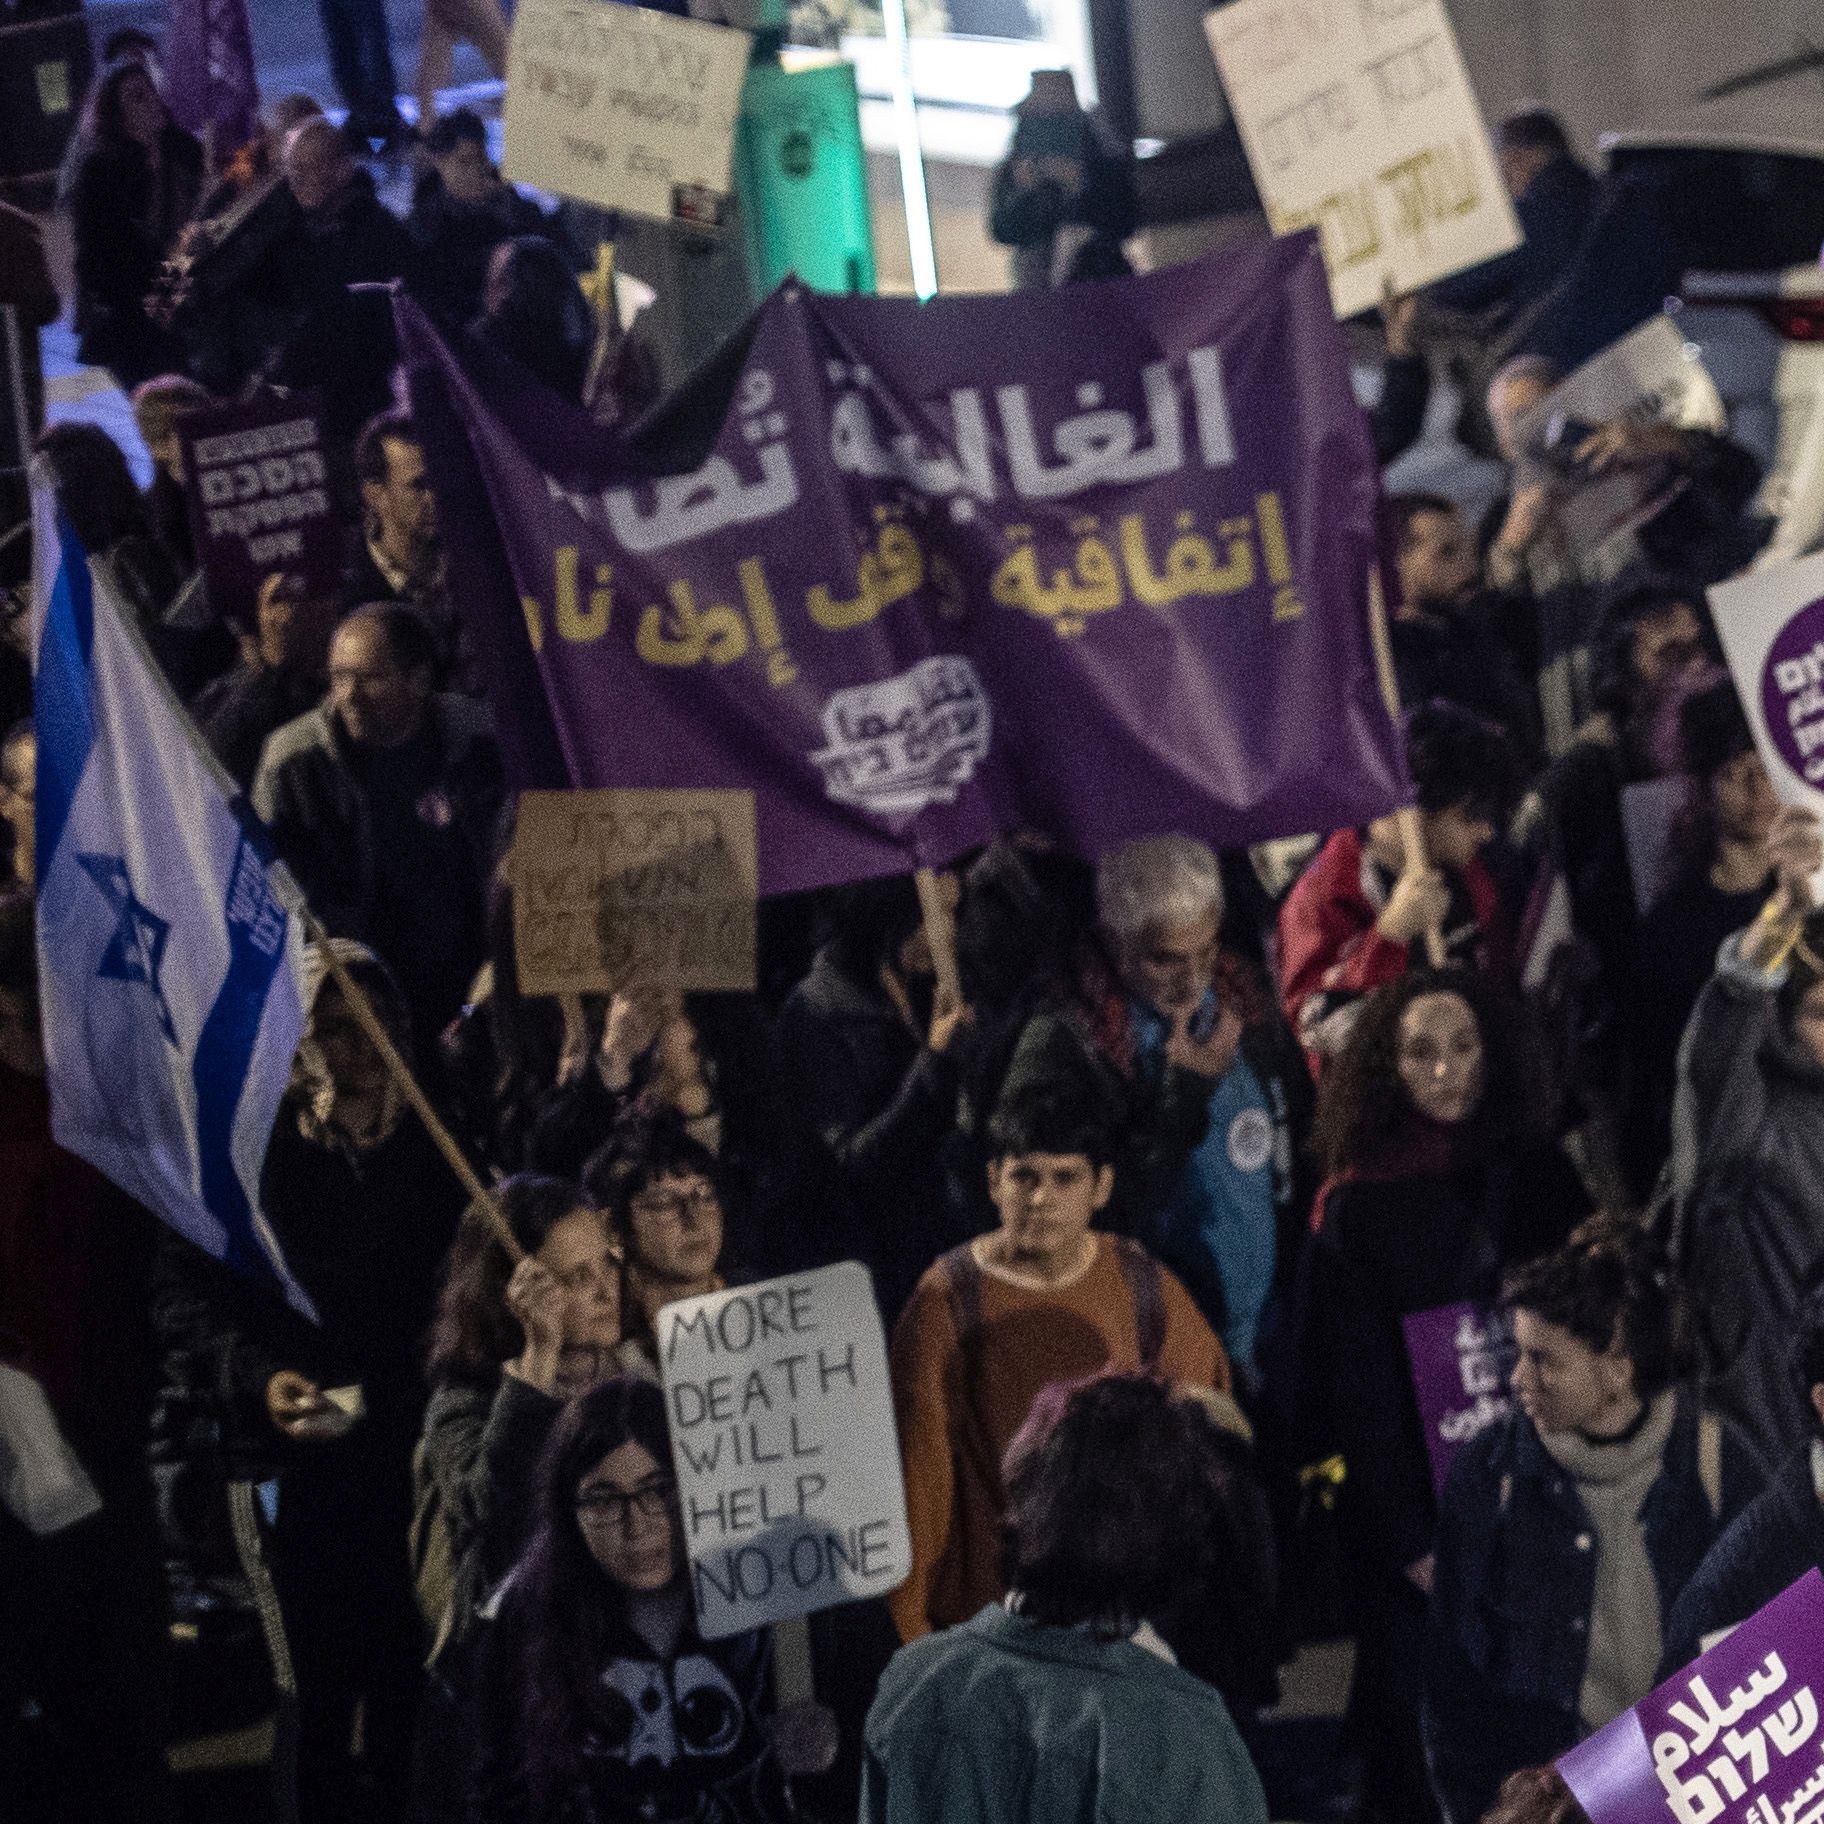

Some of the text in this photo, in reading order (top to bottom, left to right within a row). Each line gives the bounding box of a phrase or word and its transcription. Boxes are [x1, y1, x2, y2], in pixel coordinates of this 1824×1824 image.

[668, 1284, 820, 1364] MORE
[672, 1342, 857, 1430] DEATH
[680, 1415, 825, 1476] WILL
[689, 1473, 827, 1537] HELP
[1652, 1650, 1789, 1795] سلام
